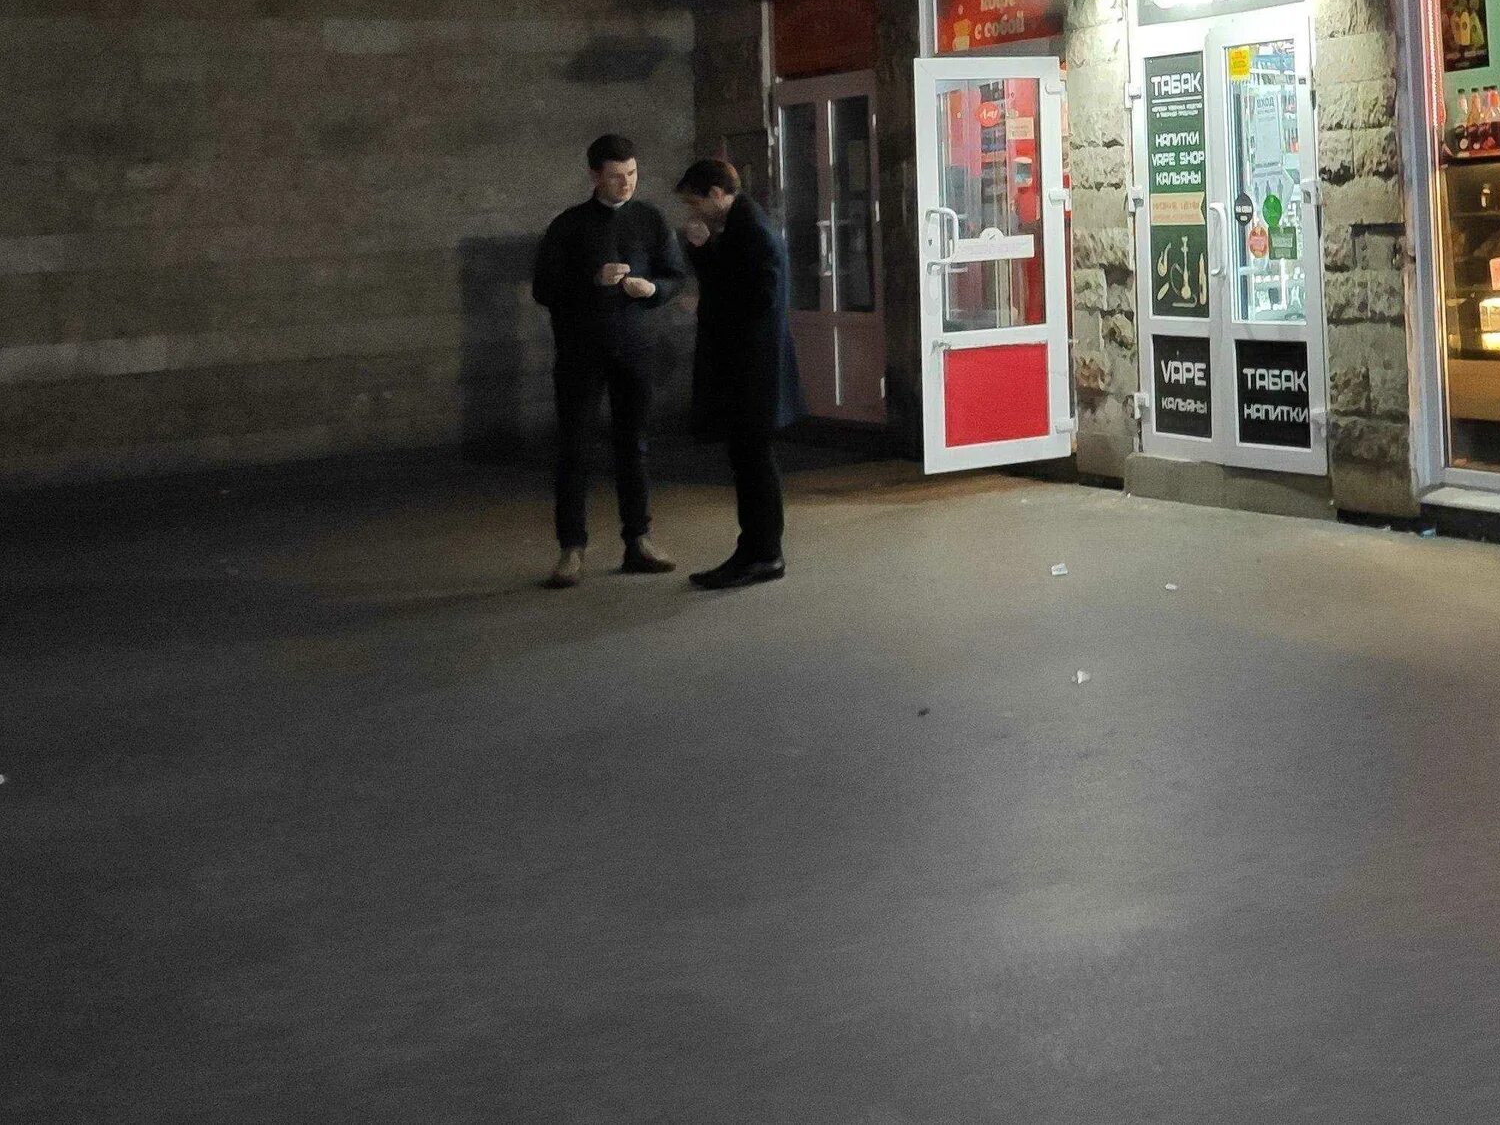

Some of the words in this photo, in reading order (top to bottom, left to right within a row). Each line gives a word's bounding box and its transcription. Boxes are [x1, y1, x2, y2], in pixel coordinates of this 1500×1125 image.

[1150, 72, 1202, 97] ТАБАК
[1155, 131, 1200, 148] НАПИТКИ
[1152, 152, 1176, 167] VAPE
[1179, 150, 1205, 166] SHOP
[1156, 170, 1202, 187] КАЛЬЯНЫ
[1160, 359, 1207, 386] VAPE
[1242, 367, 1308, 392] ТАБАК
[1161, 396, 1208, 415] КАЛЬЯНЫ
[1243, 402, 1309, 424] НАПИТКИ
